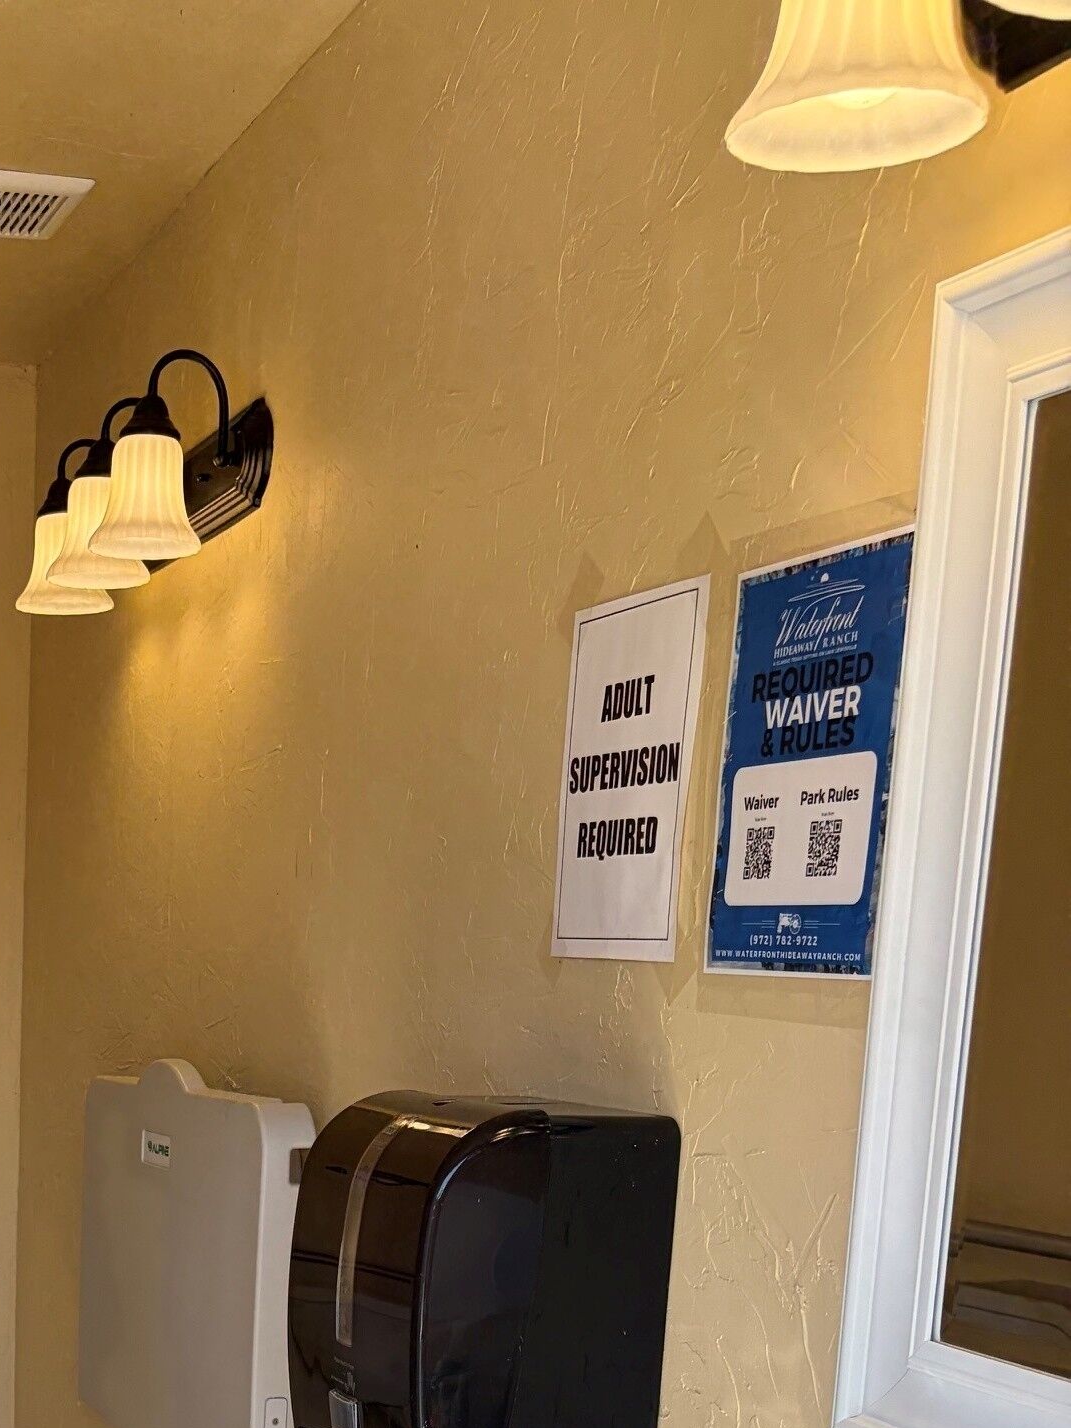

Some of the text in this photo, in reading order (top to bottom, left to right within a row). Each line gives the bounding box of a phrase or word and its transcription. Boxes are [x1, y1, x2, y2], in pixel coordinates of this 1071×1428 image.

[773, 641, 816, 660] HIDEAWAY
[822, 630, 859, 648] RANCH
[775, 595, 865, 651] Waterfront
[600, 674, 656, 723] ADULT
[752, 651, 875, 704] REQUIRED
[765, 685, 862, 730] WAIVER
[760, 715, 856, 758] & RULES
[569, 742, 680, 794] SUPERVISION
[743, 793, 780, 811] Waiver
[800, 785, 860, 806] Park Rules
[576, 816, 659, 861] REQUIRED
[715, 949, 862, 962] WWW.WATERFRONTHIDEAWAYRANCH.COM
[749, 934, 819, 947] (972) 782-9722
